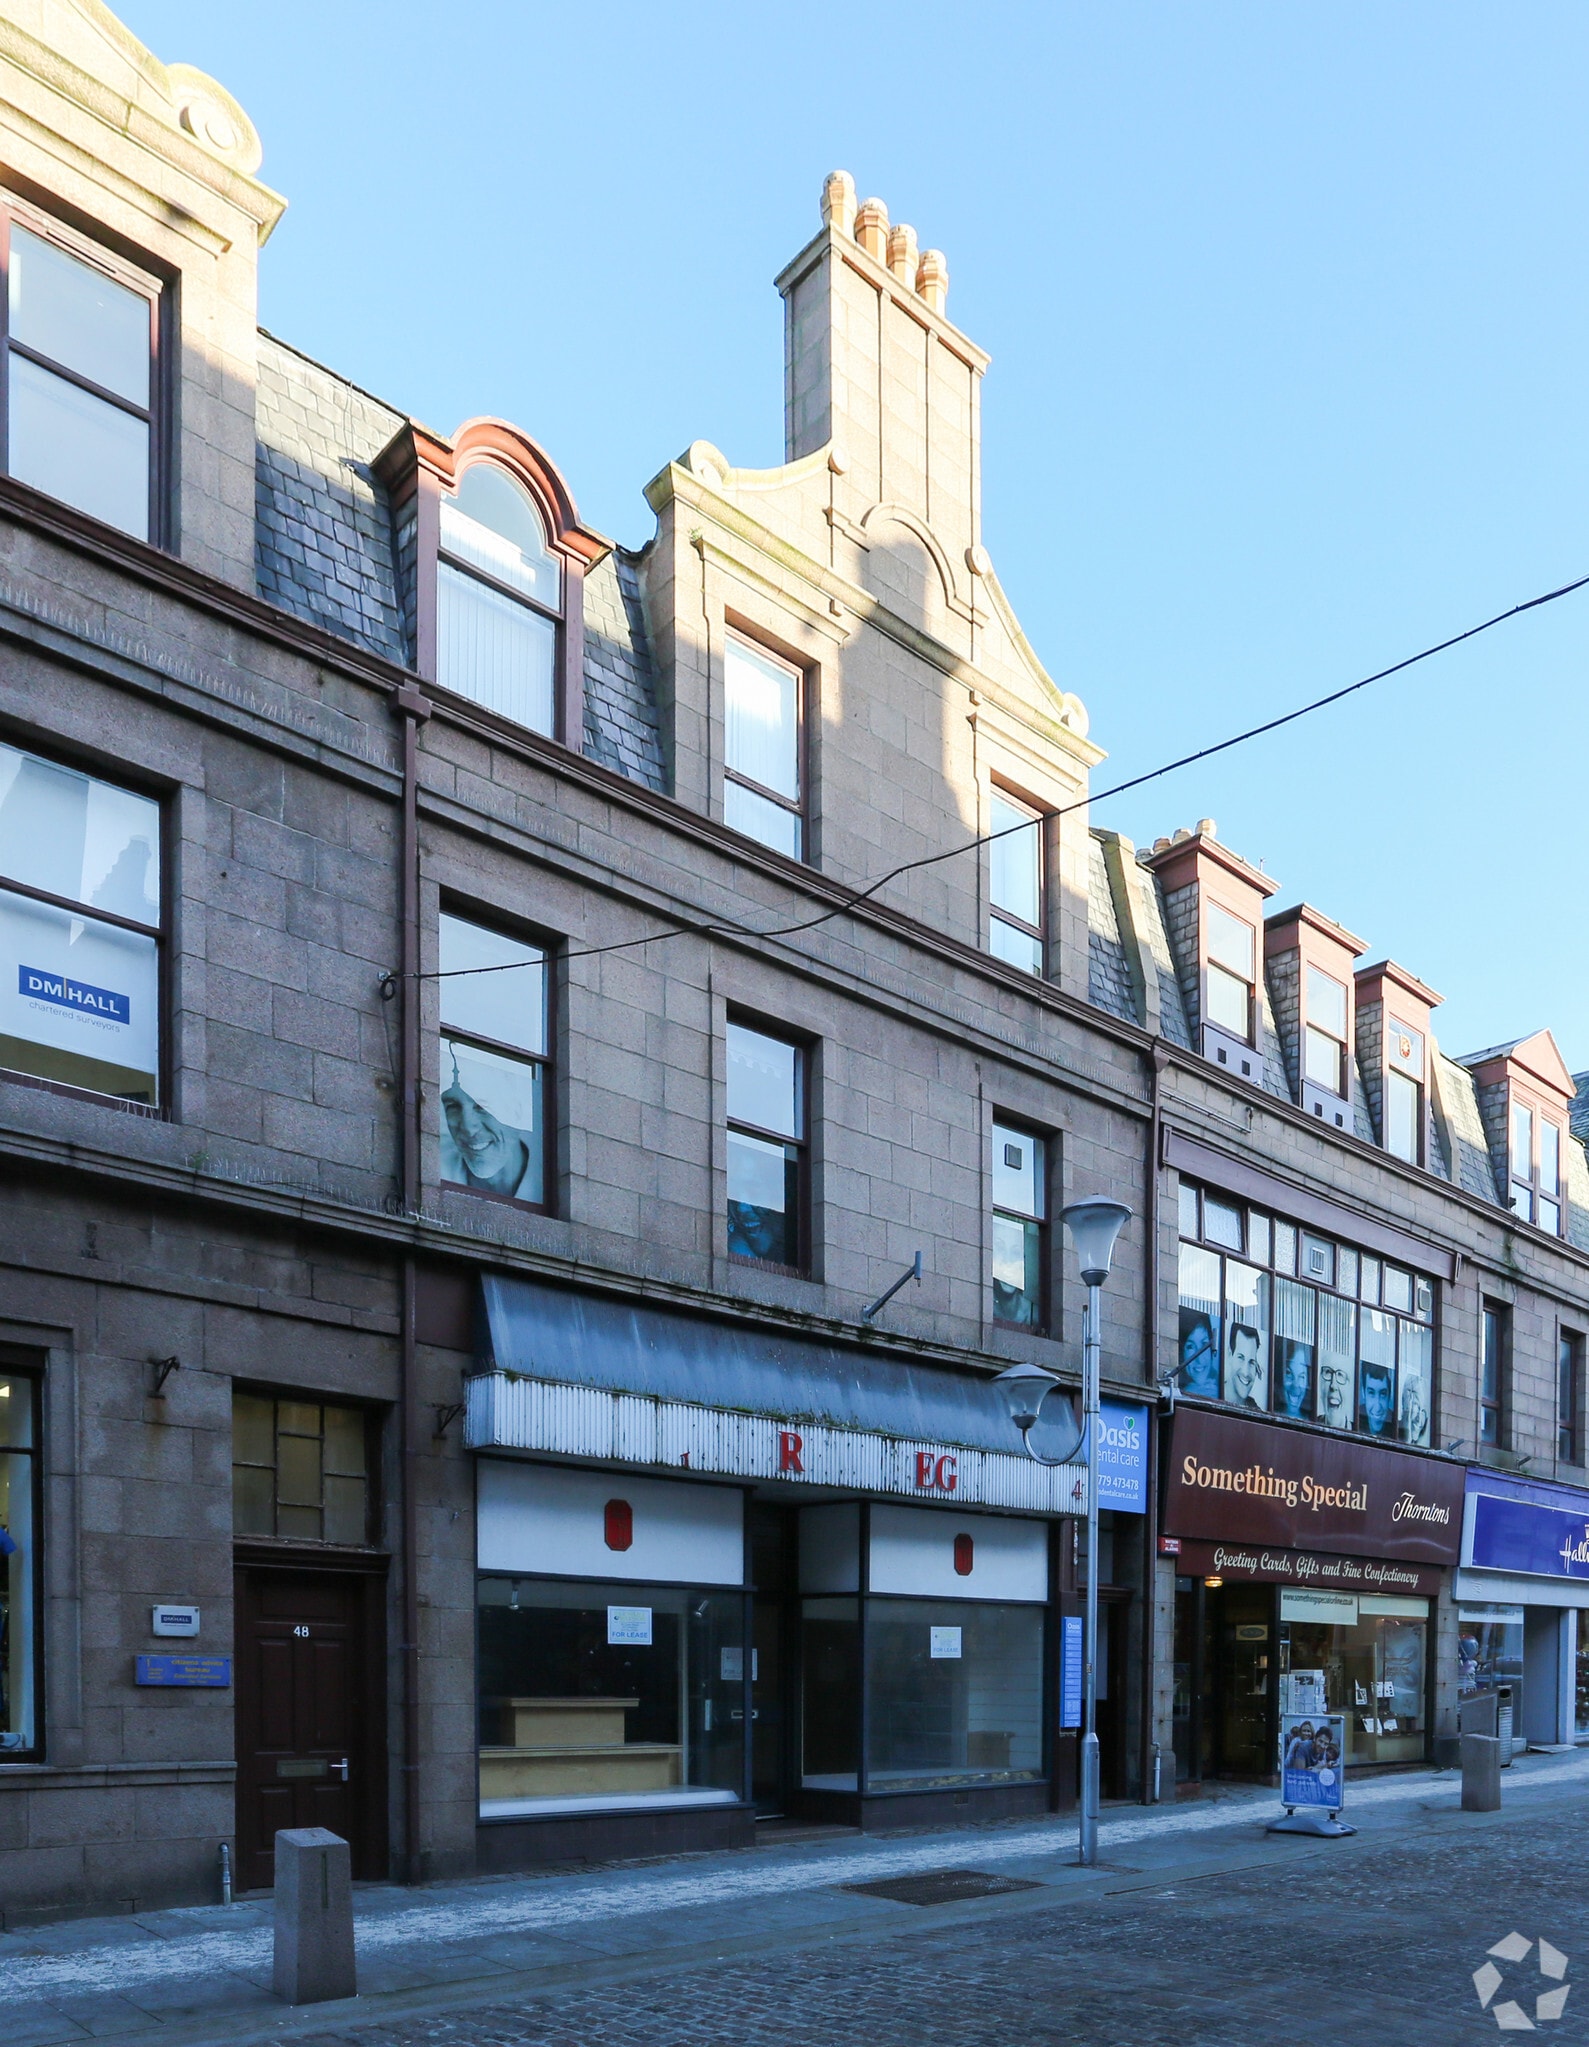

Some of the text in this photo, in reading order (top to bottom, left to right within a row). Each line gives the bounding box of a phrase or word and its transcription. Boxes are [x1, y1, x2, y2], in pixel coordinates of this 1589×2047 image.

[29, 1000, 121, 1033] chartered surveyors
[778, 1431, 805, 1472] R
[1097, 1449, 1140, 1467] ental care
[1098, 1474, 1139, 1490] 779 473478
[1181, 1455, 1368, 1511] Something Special
[1391, 1492, 1450, 1525] Thorntons
[1214, 1547, 1419, 1589] Greeting Cards, Gifts and Fine Confectionery
[293, 1625, 310, 1638] 48
